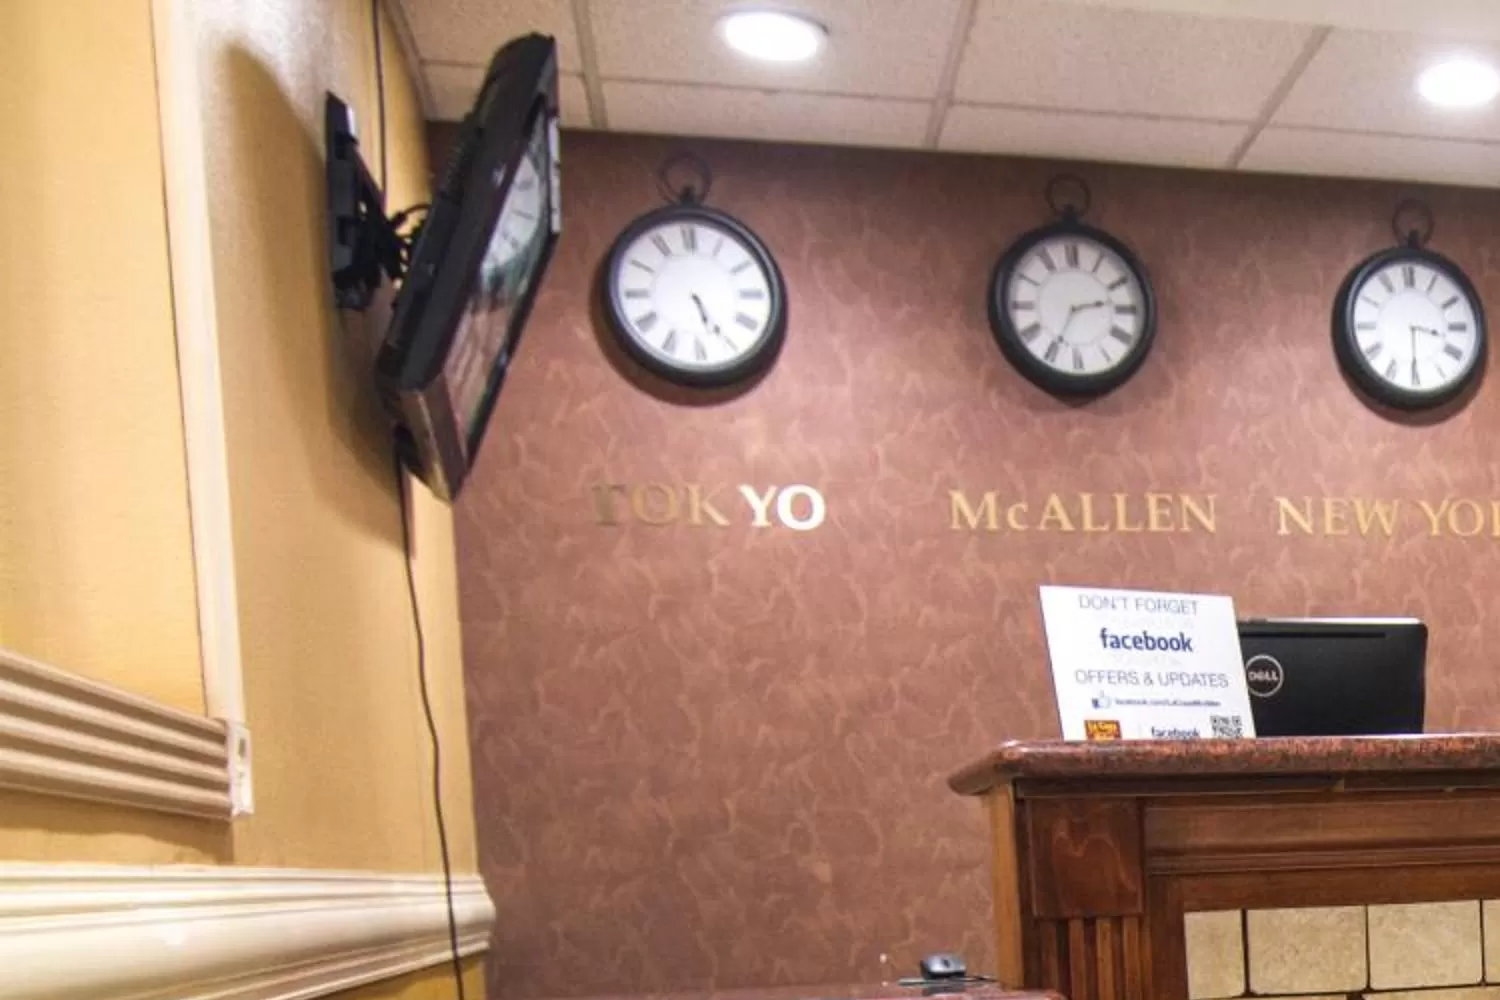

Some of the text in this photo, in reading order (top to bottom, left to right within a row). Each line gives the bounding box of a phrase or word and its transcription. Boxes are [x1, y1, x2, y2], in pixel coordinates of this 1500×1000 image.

[592, 483, 826, 531] TOKYO
[947, 488, 1219, 535] McALLEN
[1273, 496, 1400, 538] NEW
[1135, 597, 1199, 616] FORGET
[1100, 627, 1194, 653] facebook
[1075, 668, 1230, 690] OFFERS & UPDATES
[1248, 669, 1279, 682] DELL
